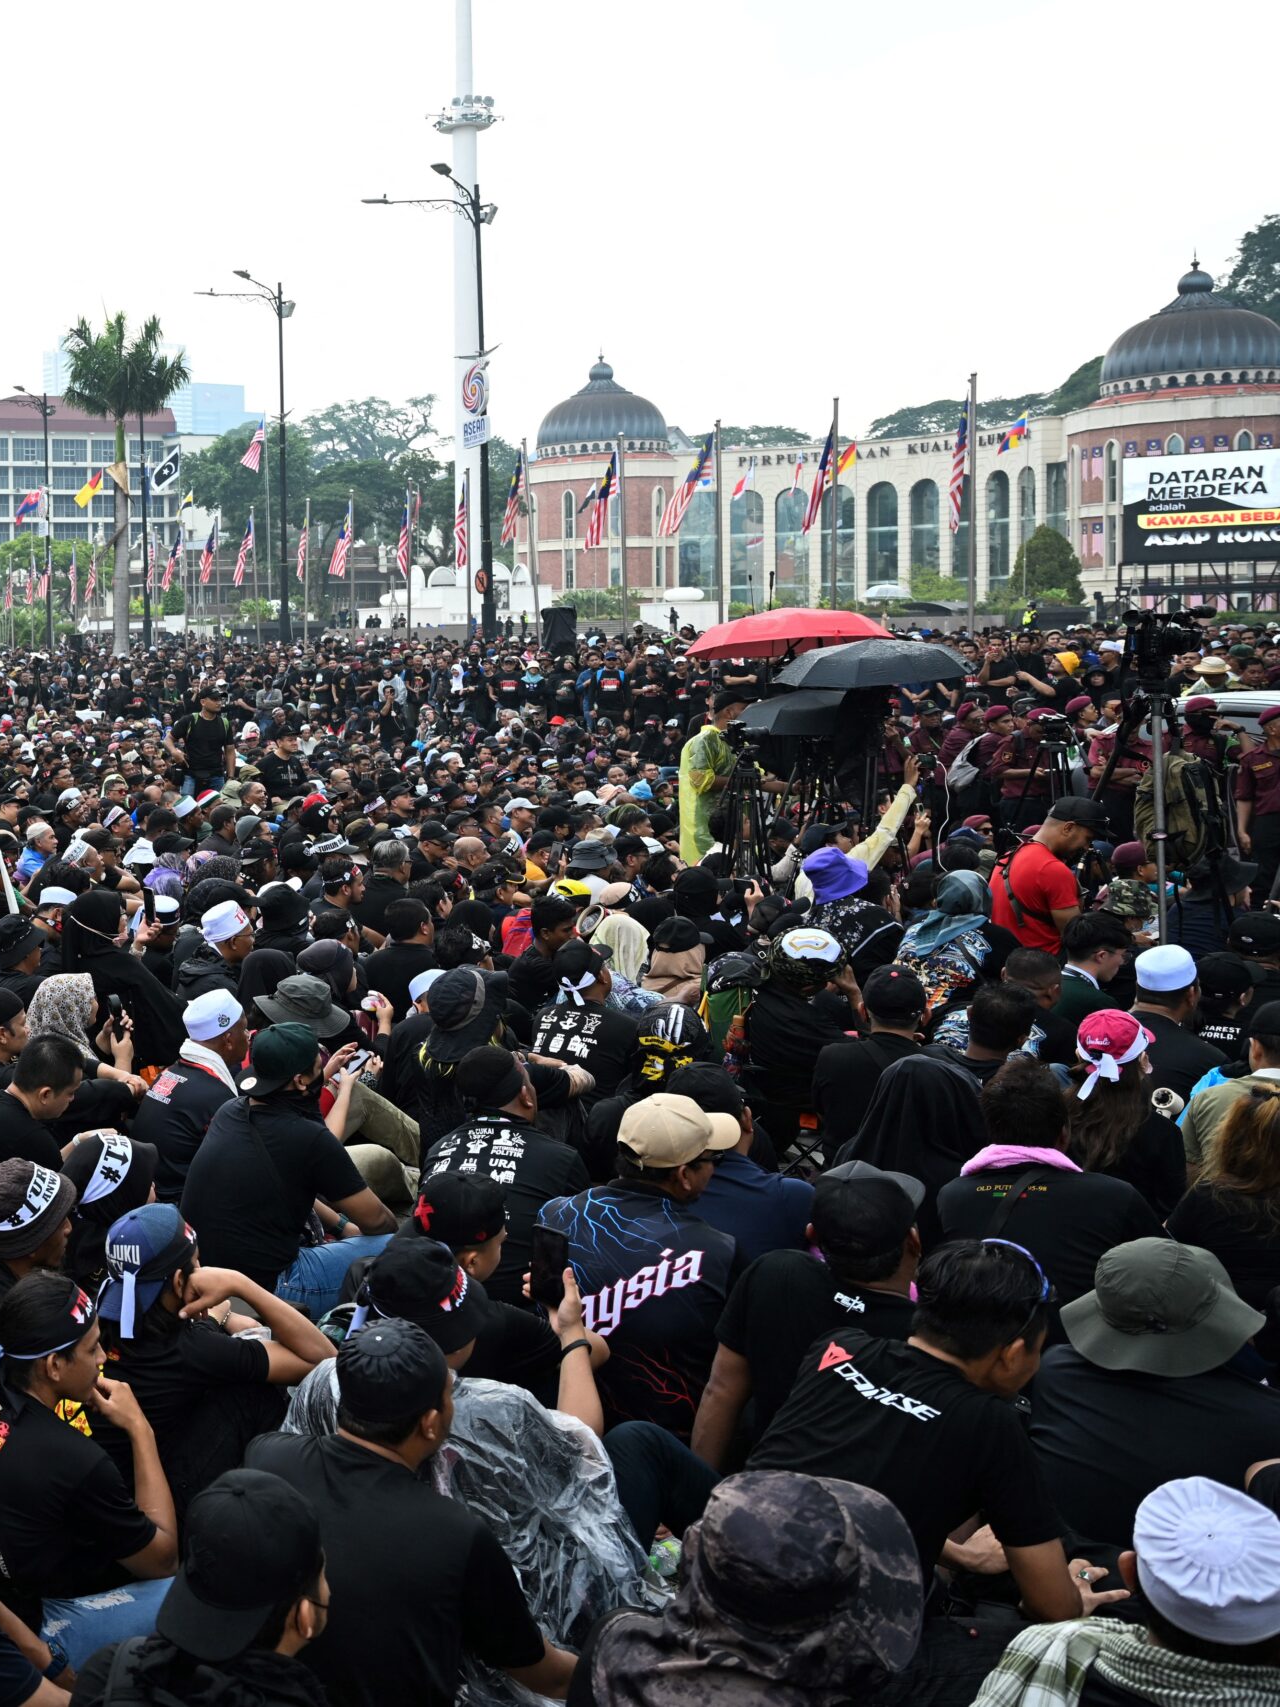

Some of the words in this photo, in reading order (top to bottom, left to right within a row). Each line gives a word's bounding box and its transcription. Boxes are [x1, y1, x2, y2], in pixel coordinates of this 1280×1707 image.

[463, 418, 485, 437] ASEAN
[738, 446, 891, 467] PERPUSTAAN
[907, 440, 953, 455] KUAL
[1148, 465, 1264, 485] DATARAN
[1147, 481, 1268, 501] MERDEKA
[1148, 502, 1186, 512] adalah
[1146, 513, 1235, 527] KAWASAN
[1144, 530, 1211, 547] ASAP
[490, 1149, 523, 1158] POLITIK
[489, 1158, 517, 1171] URA
[580, 1247, 706, 1337] aysia
[833, 1362, 942, 1422] DAINESE
